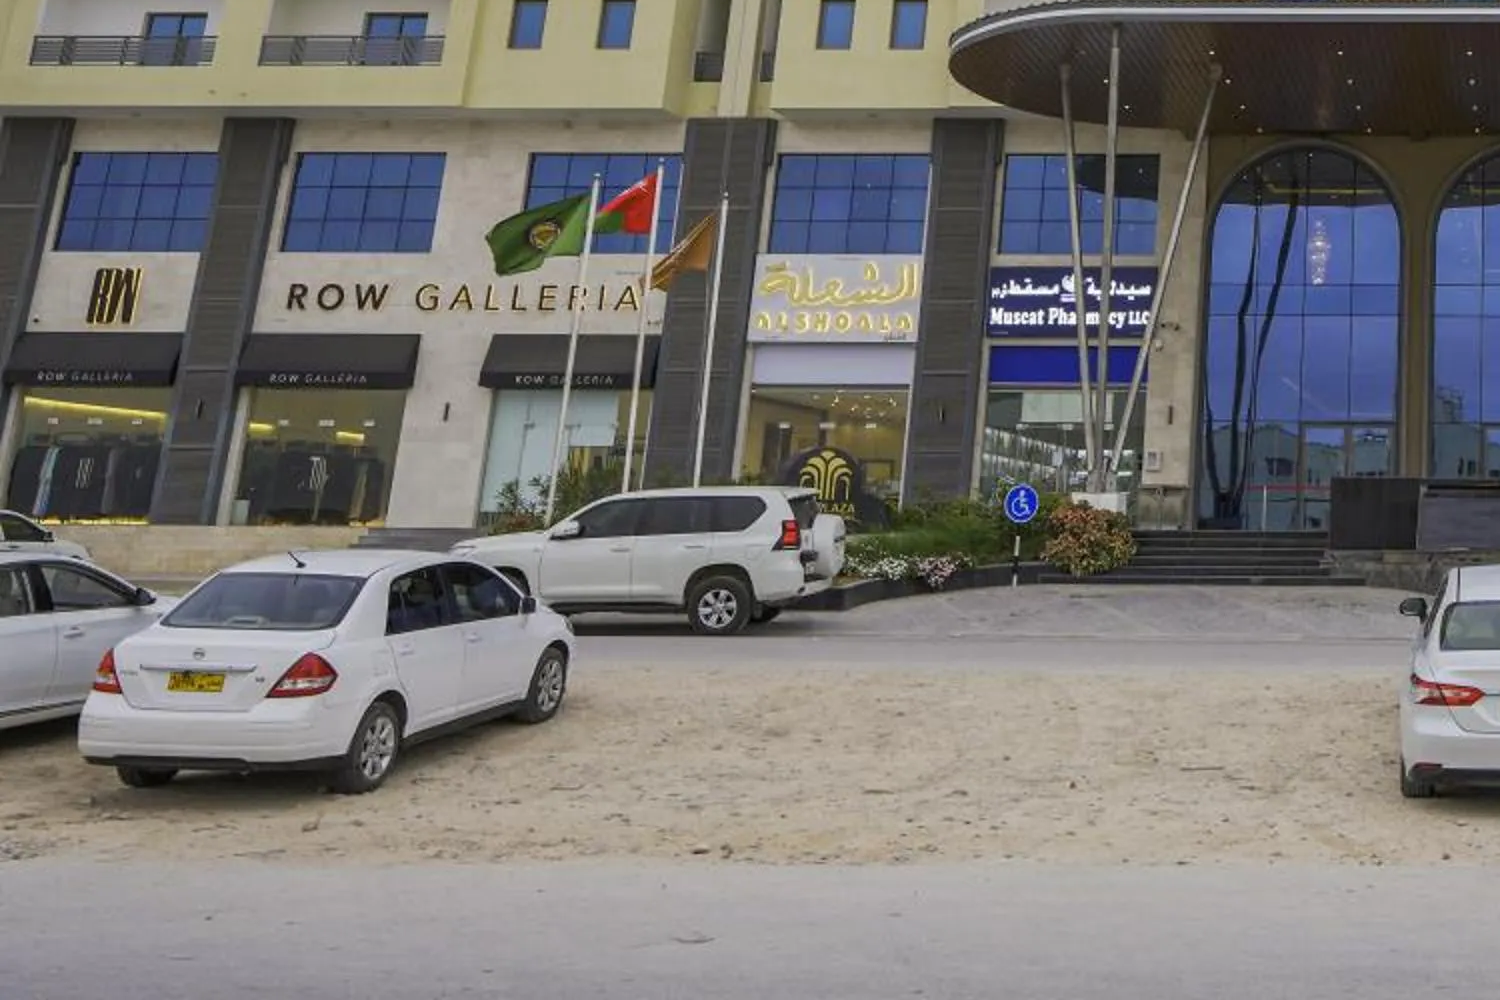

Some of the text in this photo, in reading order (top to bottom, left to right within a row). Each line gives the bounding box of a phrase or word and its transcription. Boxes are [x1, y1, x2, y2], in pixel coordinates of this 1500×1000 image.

[759, 260, 919, 308] الشعلة
[286, 283, 640, 312] ROW GALLERIA
[755, 311, 914, 333] ALSHOALA
[989, 307, 1150, 329] Muscat Phamcy LLC
[36, 370, 67, 382] ROW
[269, 373, 368, 384] ROW GALLERIA
[515, 375, 614, 386] ROW GALERIA
